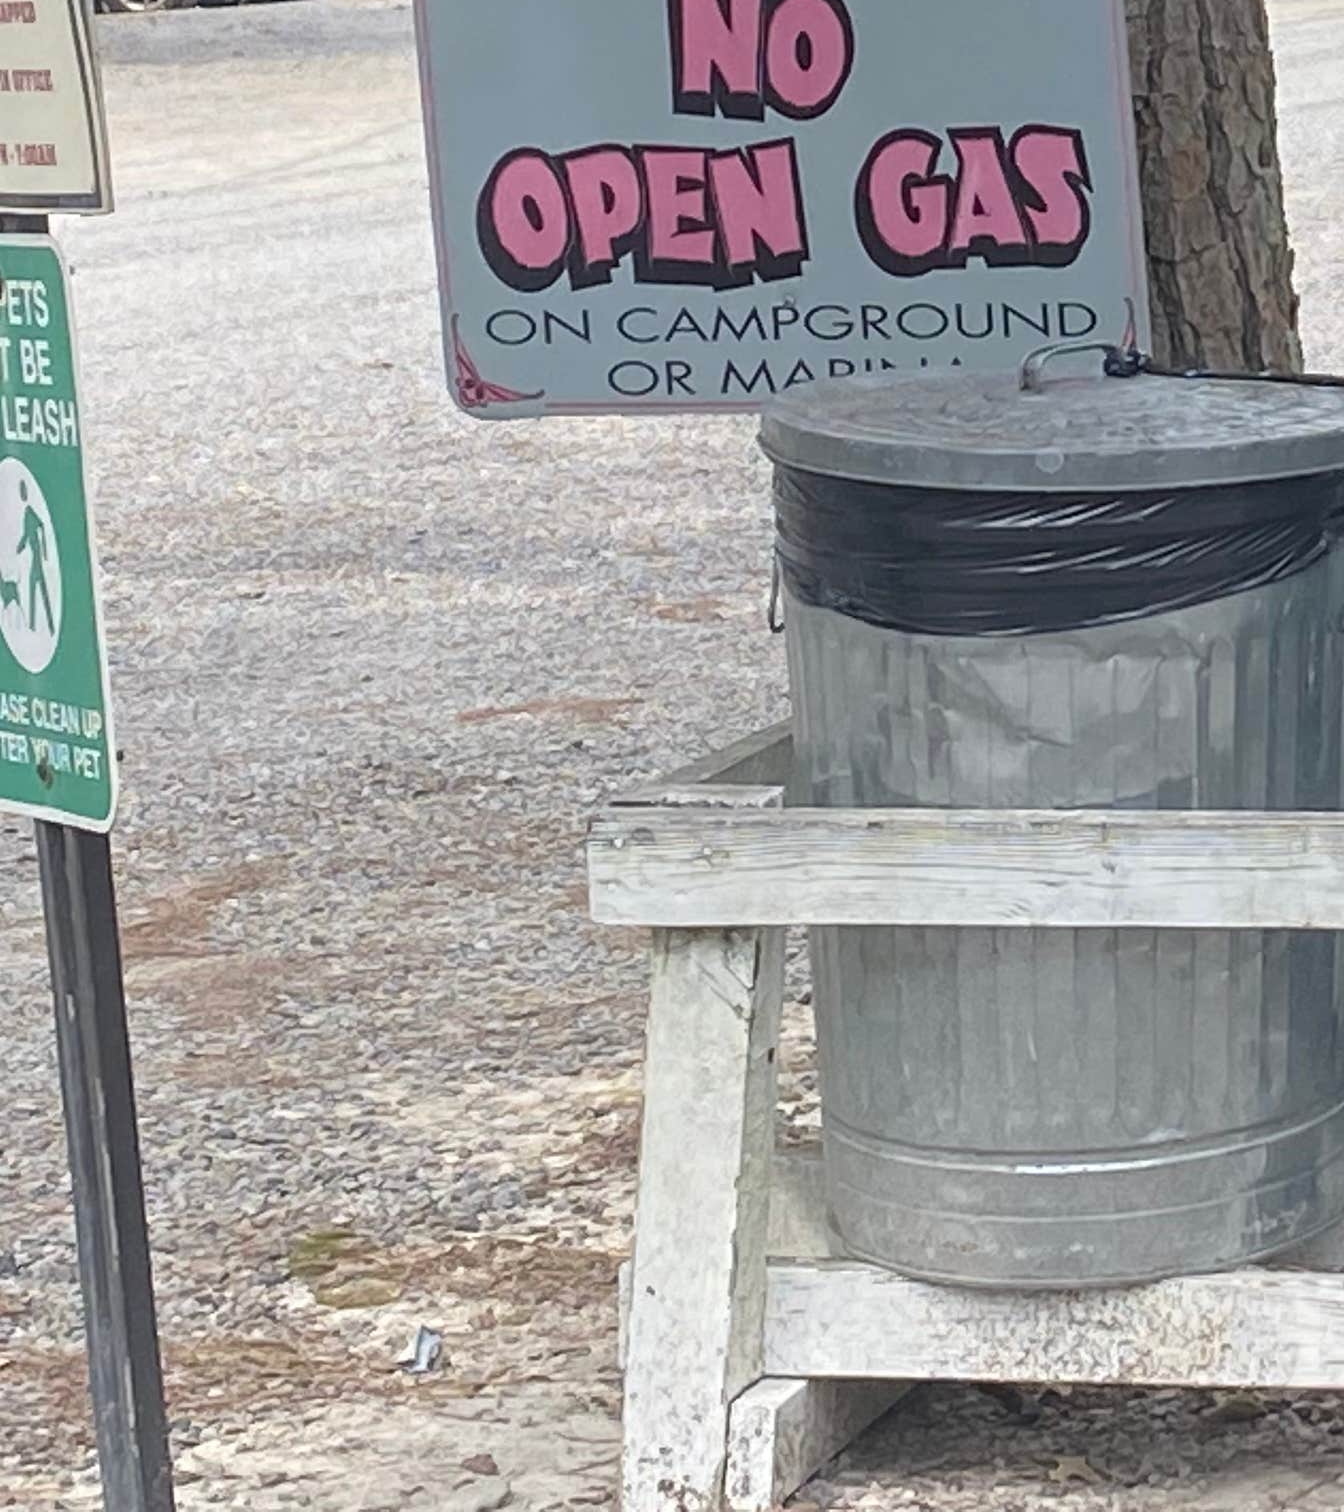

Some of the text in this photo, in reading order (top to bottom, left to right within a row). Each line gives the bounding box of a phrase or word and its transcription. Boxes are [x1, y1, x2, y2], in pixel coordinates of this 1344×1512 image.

[477, 123, 1092, 291] OPEN GAS
[485, 301, 1098, 346] ON CAMPGROUND
[20, 338, 53, 385] BE
[607, 359, 696, 396] OR
[2, 395, 79, 447] LEASH
[31, 696, 80, 736] CLEAN
[82, 708, 102, 740] UP
[29, 736, 72, 774] YOUR
[73, 745, 101, 780] PET
